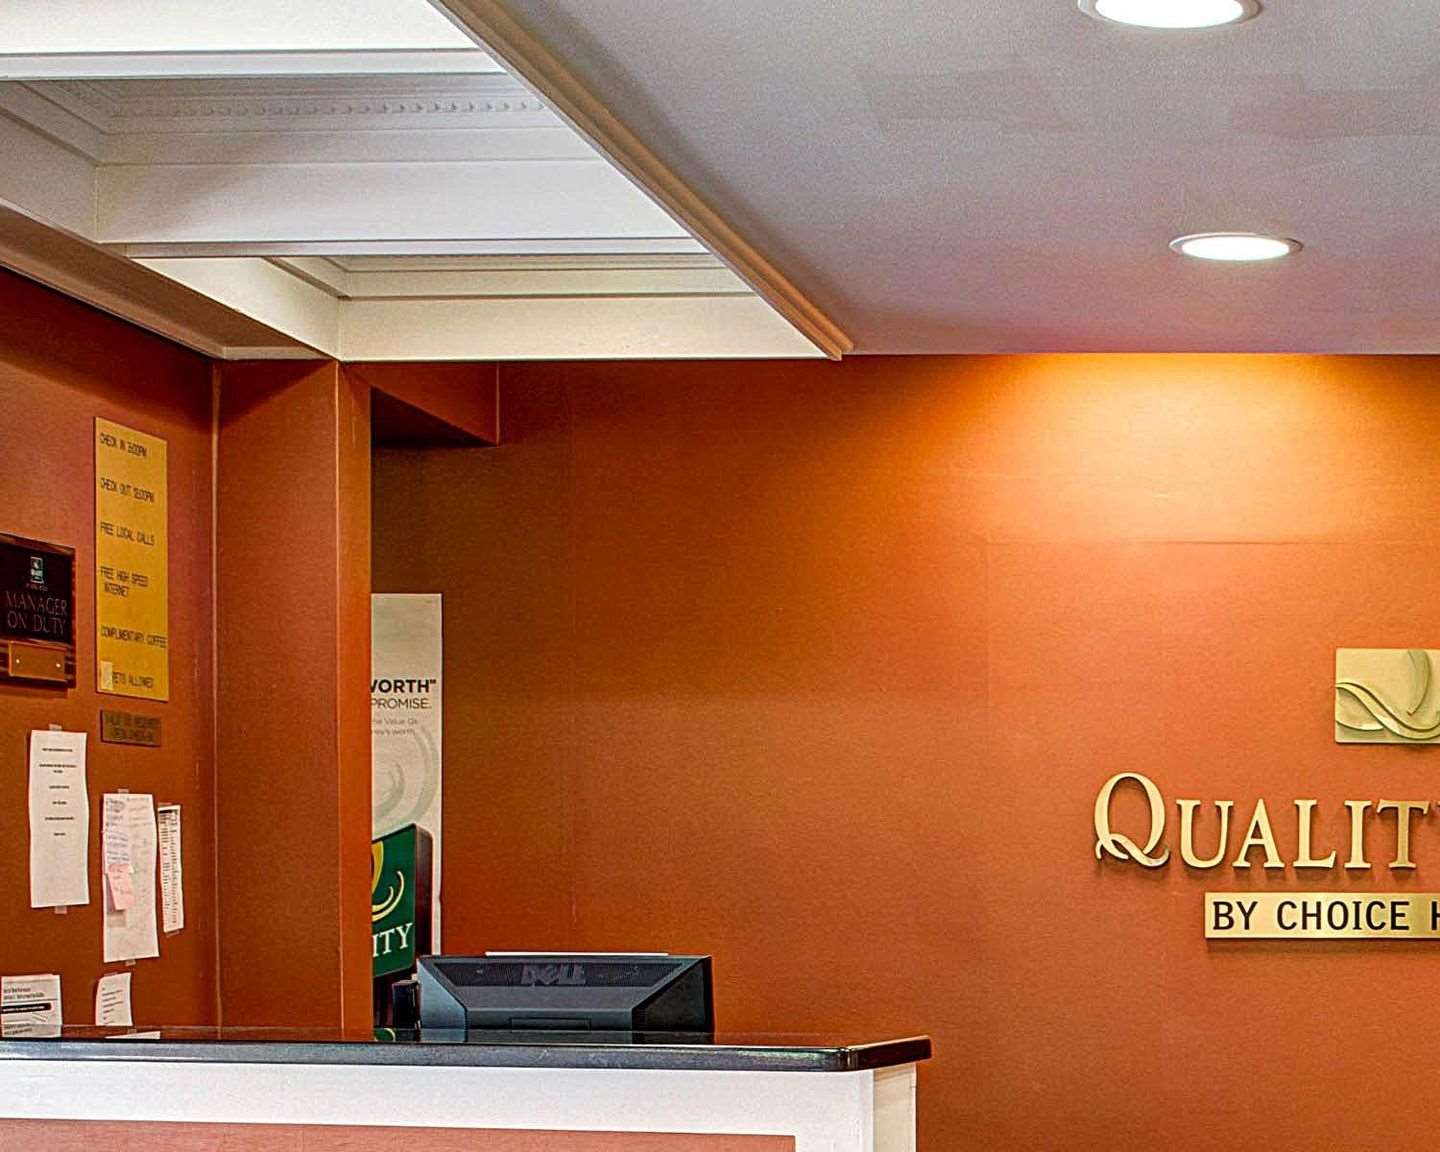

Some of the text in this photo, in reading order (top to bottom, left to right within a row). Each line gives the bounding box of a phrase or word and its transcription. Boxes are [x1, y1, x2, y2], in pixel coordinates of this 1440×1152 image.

[6, 590, 68, 617] MANAGER
[7, 610, 66, 636] ON DUTY
[1212, 900, 1255, 932] BY
[1276, 900, 1411, 932] CHOICE
